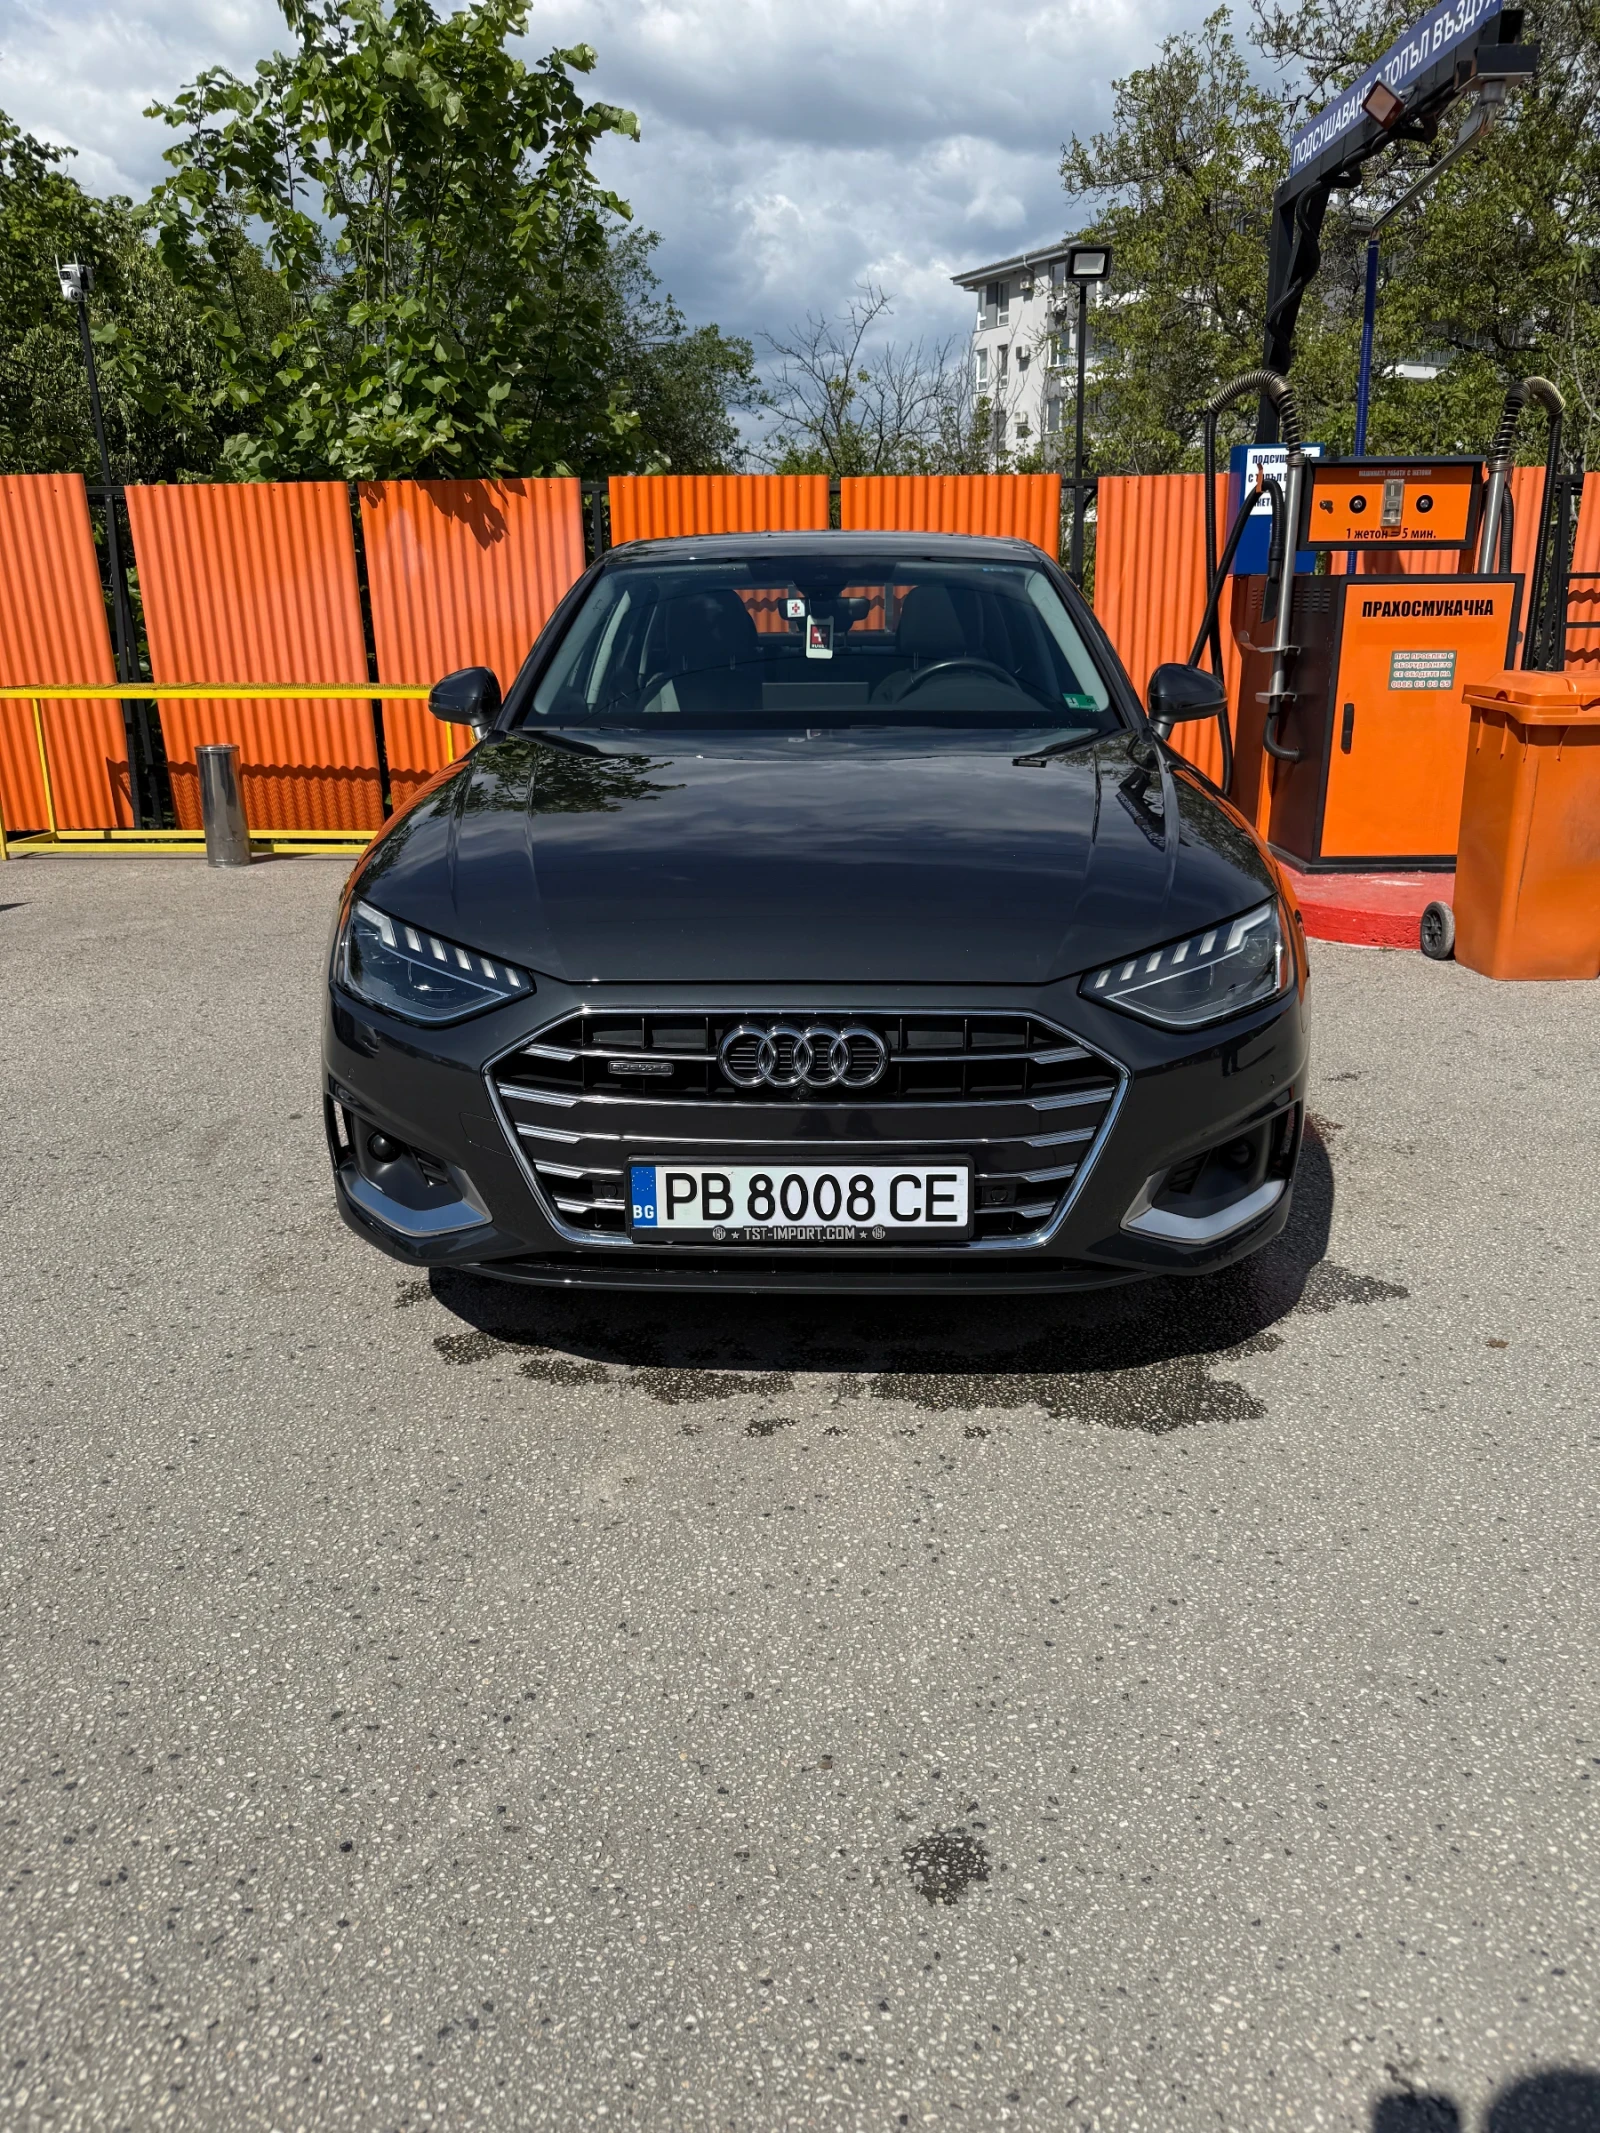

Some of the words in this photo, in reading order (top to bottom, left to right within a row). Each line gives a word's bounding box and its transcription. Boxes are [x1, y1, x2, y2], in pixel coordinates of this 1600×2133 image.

[1384, 28, 1430, 86] ТОПЪЛ
[1346, 528, 1351, 539] 1
[1354, 531, 1388, 539] жетон
[1402, 528, 1408, 539] 5
[1411, 530, 1436, 539] мин.
[1362, 599, 1493, 617] ПРАХОСМУКАЧКА
[665, 1172, 734, 1220] PB
[747, 1173, 876, 1222] 8008
[889, 1173, 958, 1222] CE
[633, 1204, 655, 1219] BG
[744, 1226, 856, 1240] TST-IMPORT.COM
